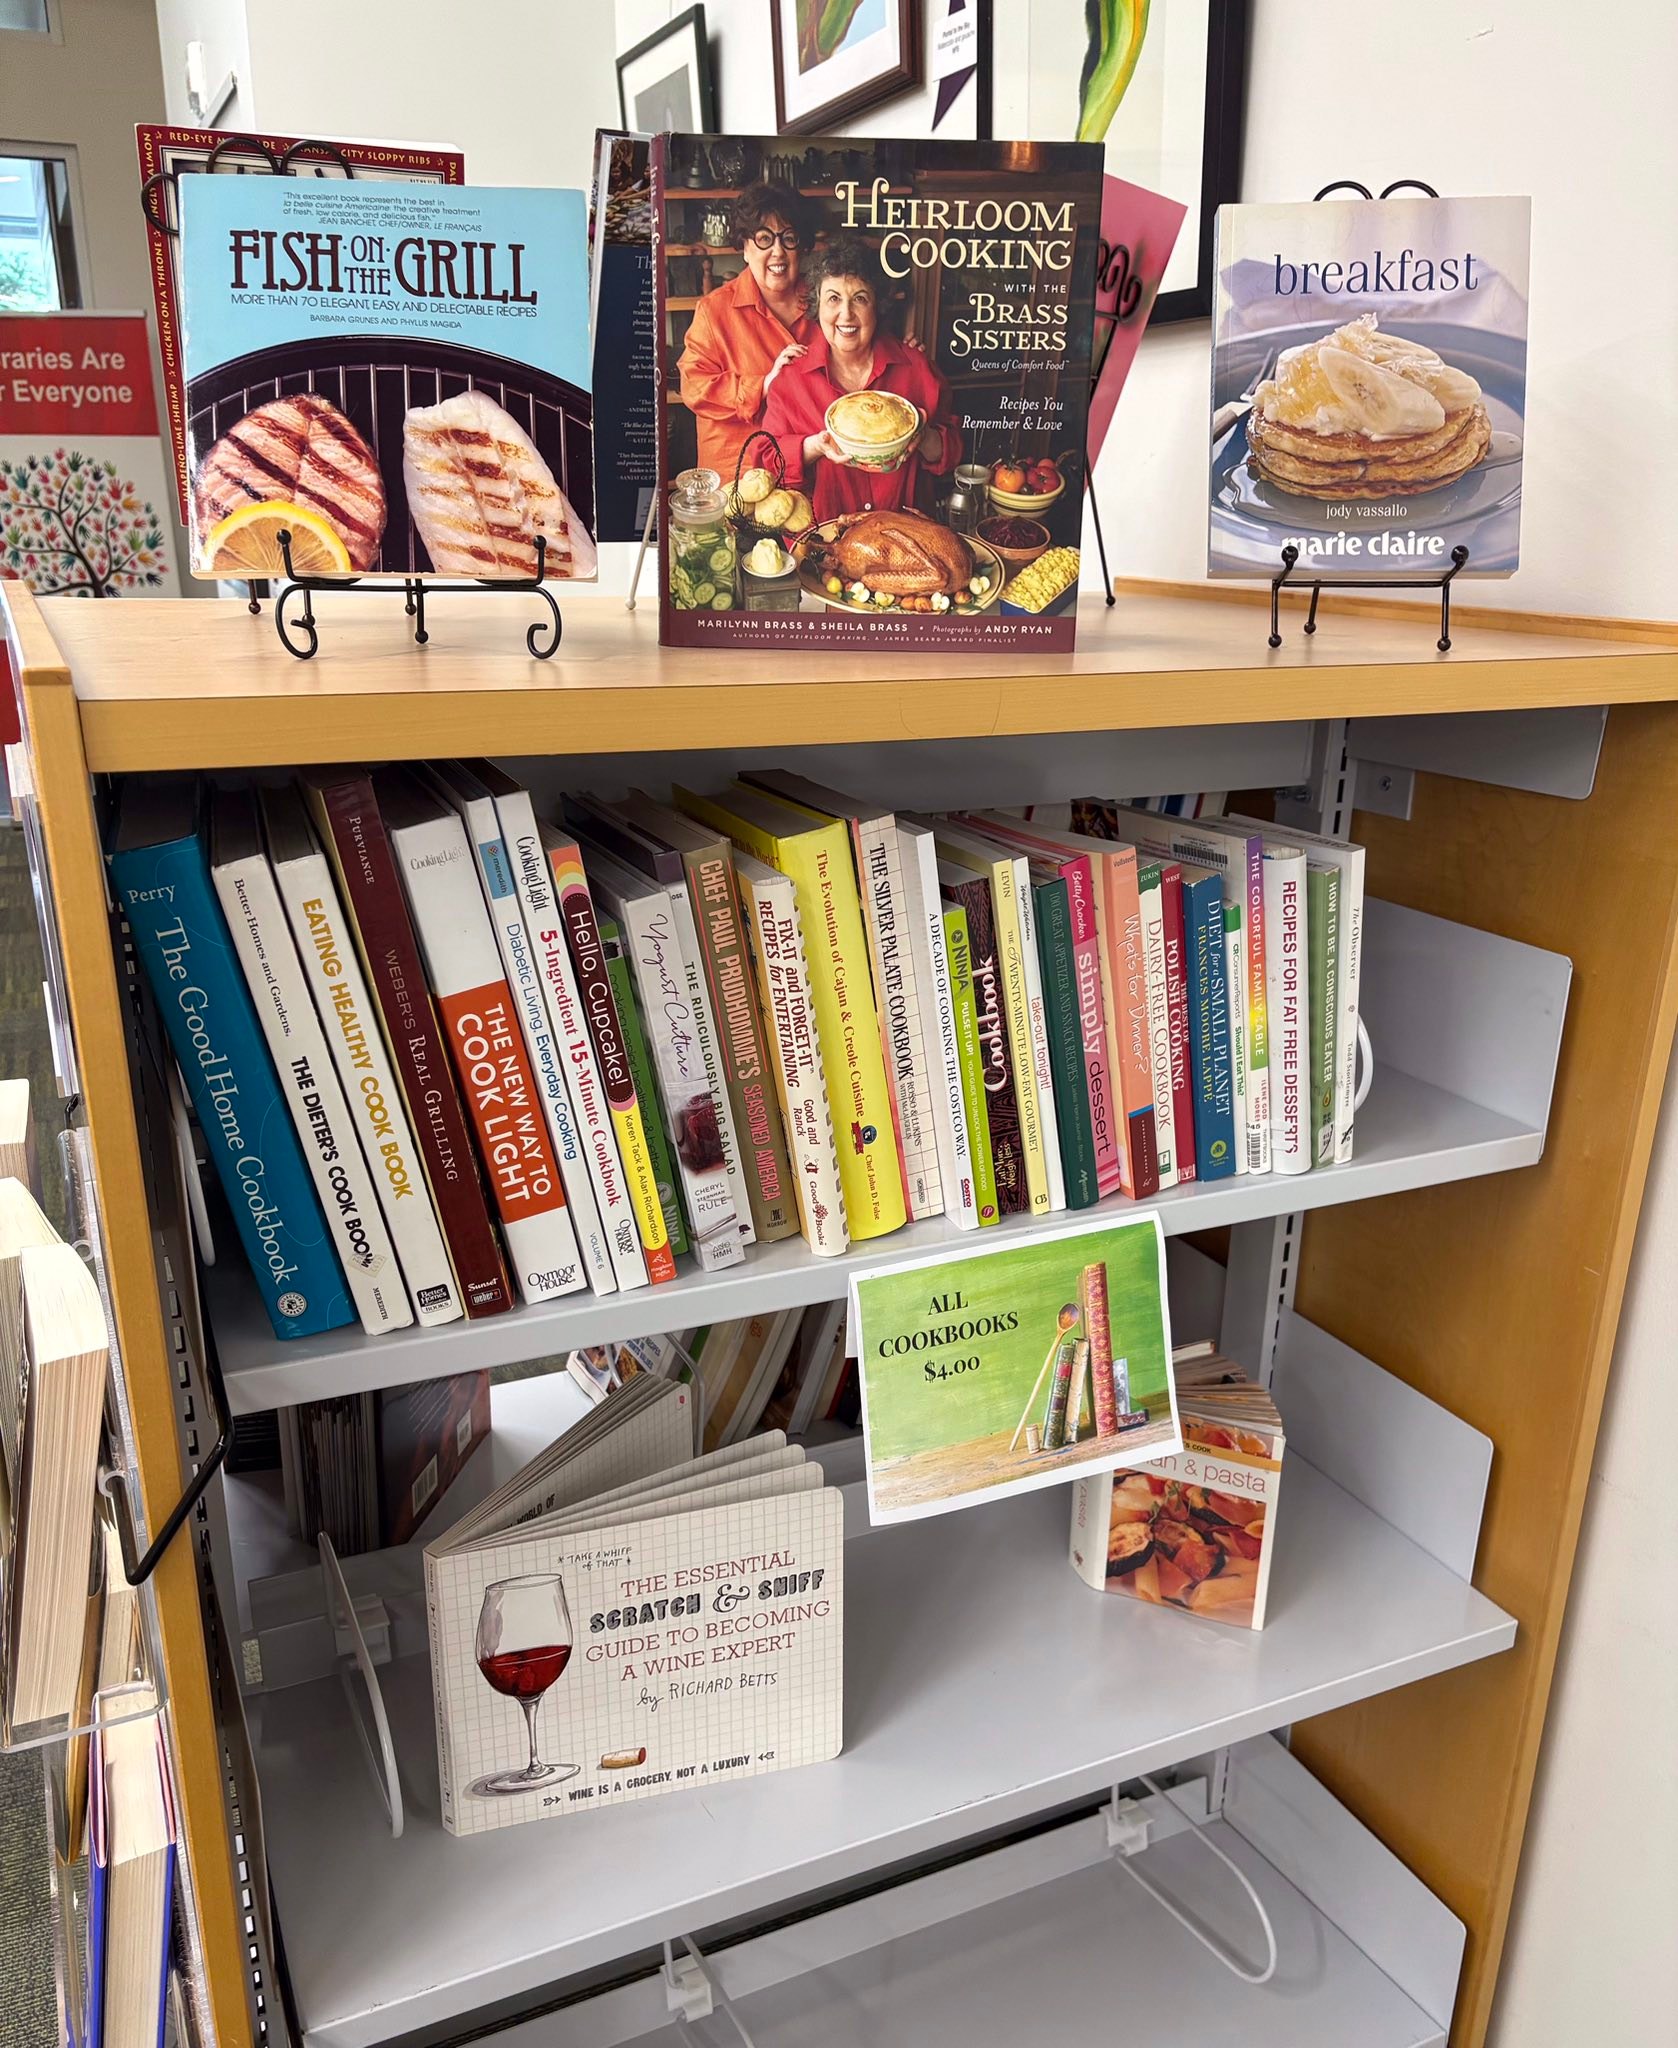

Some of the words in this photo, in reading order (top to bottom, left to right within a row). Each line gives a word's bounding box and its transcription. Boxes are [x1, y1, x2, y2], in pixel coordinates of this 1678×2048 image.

[170, 131, 214, 144] RED-EYE
[341, 149, 364, 159] CITY
[367, 151, 405, 165] SLOPPY
[409, 155, 431, 165] RIBS
[835, 177, 1075, 232] HEIRLOOM
[156, 241, 167, 287] THRONE
[229, 229, 344, 292] FISH
[344, 266, 391, 296] THE
[394, 237, 538, 305] GRILL
[880, 232, 1072, 278] COOKING
[1274, 249, 1479, 296] breakfast
[160, 290, 167, 299] A
[161, 301, 170, 318] ON
[231, 294, 265, 305] MORE
[268, 295, 298, 306] THAN
[402, 302, 428, 312] AND
[431, 303, 494, 316] DELECTABLE
[496, 306, 537, 317] RECIPES
[969, 293, 1069, 325] BRASS
[1004, 284, 1036, 293] WITH
[1044, 284, 1067, 294] THE
[81, 347, 126, 370] Are
[163, 320, 175, 367] CHICKEN
[950, 318, 1067, 357] SISTERS
[971, 359, 1000, 371] Queens
[1002, 359, 1011, 372] of
[1012, 359, 1043, 371] Comfort
[12, 380, 133, 408] Everyone
[1000, 396, 1040, 414] Recipes
[1044, 396, 1064, 411] You
[962, 415, 1020, 430] Remember
[1022, 417, 1033, 430] &
[1036, 416, 1063, 431] Love
[1326, 503, 1352, 519] jody
[1356, 502, 1408, 517] vassallo
[1367, 531, 1446, 556] claire
[697, 619, 759, 629] MARILYNN
[764, 621, 803, 630] BRASS
[808, 621, 815, 630] &
[821, 622, 864, 631] SHEILA
[869, 623, 908, 632] BRASS
[932, 625, 972, 635] Photographs
[974, 626, 982, 636] by
[985, 625, 1017, 634] ANDY
[1021, 626, 1052, 635] RYAN
[350, 816, 375, 885] PURVIANCE
[815, 849, 827, 880] The
[869, 842, 889, 881] THE
[1251, 852, 1261, 882] THE
[127, 884, 176, 905] Perry
[700, 858, 730, 904] CHEF
[1140, 870, 1160, 883] ZUKIN
[708, 907, 738, 954] PAUL
[821, 880, 841, 949] Evolution
[874, 881, 896, 935] SILVER
[1207, 899, 1223, 949] DIET
[1251, 886, 1262, 960] COLORFUL
[1283, 880, 1298, 954] RECIPES
[831, 949, 844, 965] of
[880, 933, 904, 994] PALATE
[1118, 913, 1142, 972] What's
[1211, 951, 1221, 967] for
[684, 961, 699, 991] THE
[834, 965, 849, 1009] Cajun
[1127, 973, 1143, 1000] for
[1148, 918, 1166, 1024] DAIRY-FREE
[1166, 938, 1182, 1006] POLISH
[1252, 963, 1263, 1012] FAMILY
[1283, 959, 1298, 992] FOR
[570, 910, 598, 980] Hello,
[588, 982, 629, 1088] Cupcake!
[717, 953, 762, 1082] PRUDHOMME'S
[840, 1011, 853, 1024] &
[1031, 996, 1046, 1044] take-out
[1078, 951, 1104, 1056] simply
[1211, 978, 1227, 1042] SMALL
[1283, 998, 1298, 1025] FAT
[303, 897, 343, 977] EATING
[329, 982, 374, 1069] HEALTHY
[360, 1076, 395, 1139] COOK
[380, 1141, 414, 1201] BOOK
[485, 1003, 514, 1050] THE
[506, 923, 531, 985] Diabetic
[535, 1033, 562, 1100] Everyday
[554, 1101, 578, 1161] Cooking
[692, 997, 721, 1096] RIDICULOUSLY
[843, 1025, 858, 1069] Creole
[888, 995, 916, 1082] COOKBOOK
[1128, 1004, 1150, 1075] Dinner?
[1168, 1008, 1185, 1091] COOKING
[1255, 1015, 1264, 1056] TABLE
[1283, 1029, 1298, 1071] FREE
[384, 949, 416, 1031] WEBER'S
[409, 1034, 433, 1087] REAL
[424, 1090, 459, 1182] GRILLING
[498, 1056, 530, 1108] NEW
[540, 929, 578, 1037] 5-Ingredient
[569, 1040, 600, 1127] 15-Minute
[590, 1128, 622, 1208] Cookbook
[1035, 1046, 1052, 1091] tonight!
[1153, 1027, 1172, 1132] COOKBOOK
[1214, 1045, 1231, 1116] PLANET
[155, 917, 192, 982] The
[178, 985, 230, 1070] Good
[207, 1068, 246, 1152] Home
[236, 1155, 299, 1286] Cookbook
[456, 1013, 504, 1111] COOK
[483, 1113, 531, 1202] LIGHT
[712, 1101, 726, 1127] BIG
[742, 1083, 770, 1147] SEASONED
[849, 1069, 865, 1118] Cuisine
[1089, 1060, 1112, 1157] dessert
[1284, 1074, 1299, 1155] DESSERTS
[515, 1110, 546, 1161] WAY
[718, 1131, 736, 1175] SALAD
[529, 1164, 552, 1197] TO
[755, 1149, 782, 1202] AMERICA
[928, 1291, 968, 1316] ALL
[879, 1310, 1019, 1359] COOKBOOKS
[924, 1355, 981, 1384] $4.00
[620, 1574, 667, 1598] THE
[673, 1550, 796, 1588] ESSENTIAL
[589, 1592, 701, 1634] SCRATCH
[712, 1583, 750, 1613] &
[757, 1568, 825, 1600] SNIFF
[586, 1633, 660, 1663] GUIDE
[666, 1627, 699, 1647] TO
[706, 1600, 831, 1639] BECOMING
[620, 1665, 638, 1682] A
[643, 1651, 706, 1677] WINE
[711, 1631, 797, 1664] EXPERT
[637, 1687, 664, 1713] by
[669, 1677, 733, 1700] RICHARD
[739, 1671, 779, 1690] BETTS
[568, 1787, 595, 1802] WINE
[598, 1784, 610, 1796] IS
[614, 1781, 622, 1793] A
[676, 1766, 697, 1780] NOT
[701, 1763, 709, 1774] A
[712, 1754, 751, 1773] LUXURY
